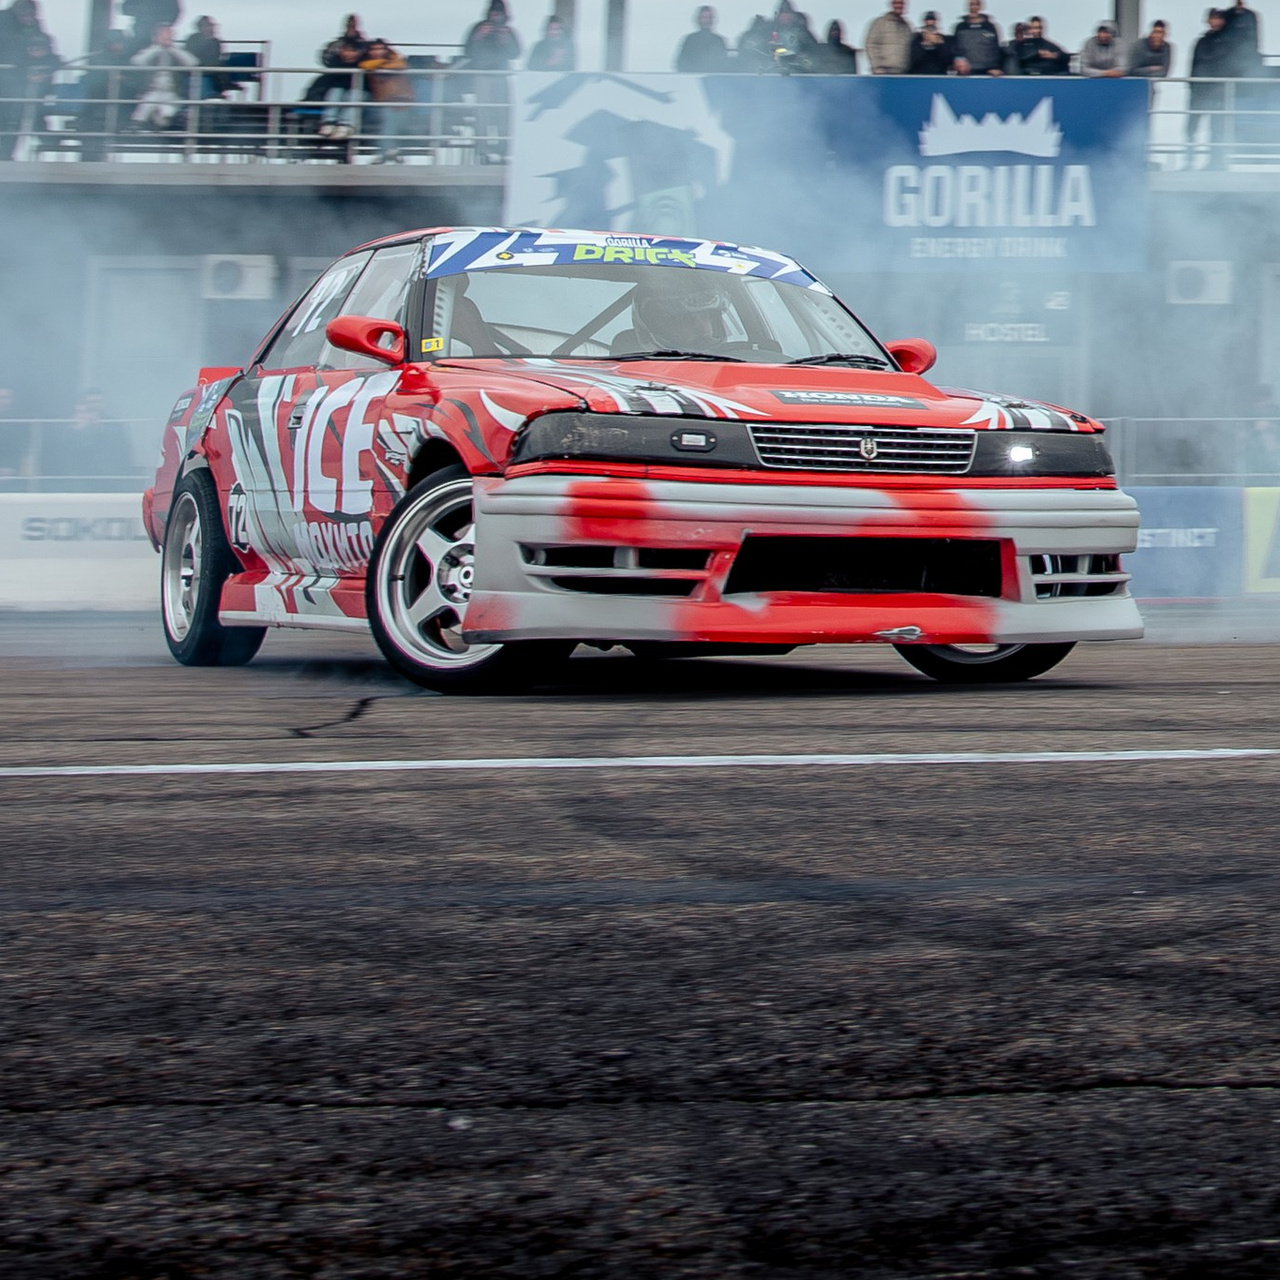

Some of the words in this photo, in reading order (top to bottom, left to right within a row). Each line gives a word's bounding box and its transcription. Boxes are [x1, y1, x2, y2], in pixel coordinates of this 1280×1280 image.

[884, 165, 1096, 227] GORILLA
[606, 235, 651, 248] GORILLA
[573, 243, 696, 267] DRIFT
[779, 391, 915, 404] HONDA
[228, 494, 249, 544] 72
